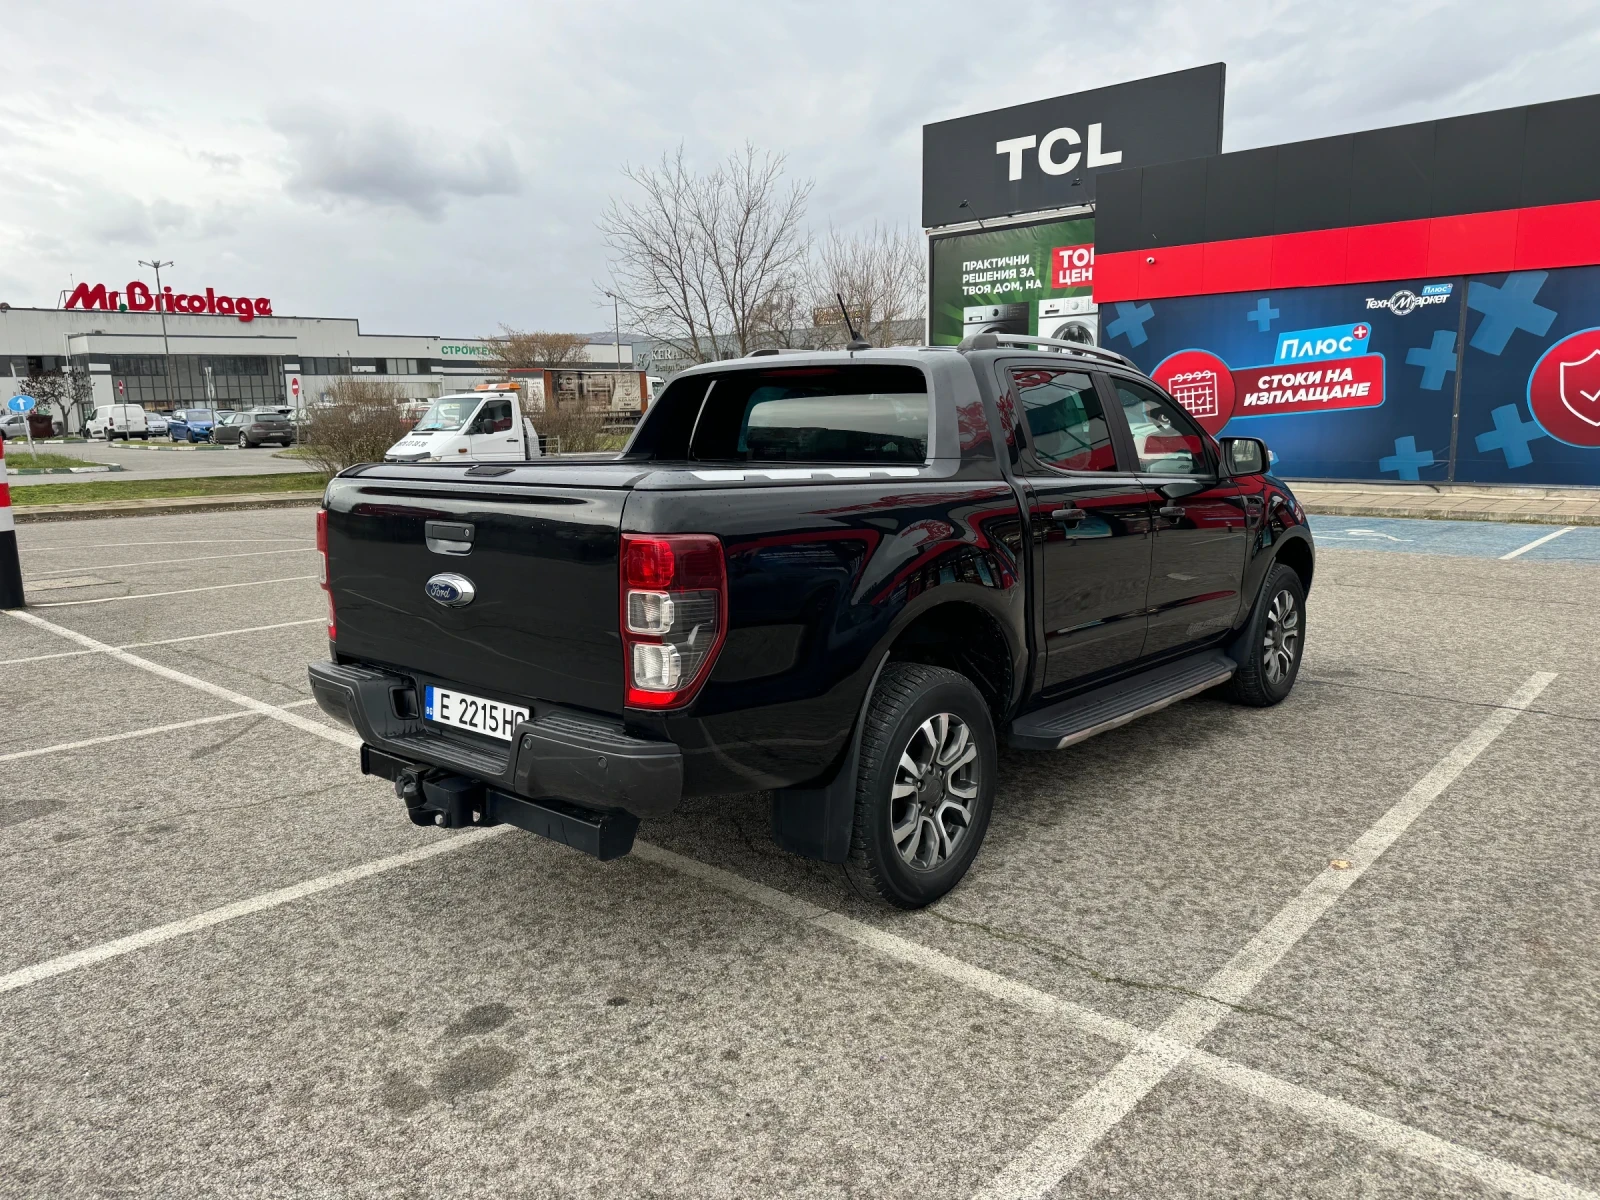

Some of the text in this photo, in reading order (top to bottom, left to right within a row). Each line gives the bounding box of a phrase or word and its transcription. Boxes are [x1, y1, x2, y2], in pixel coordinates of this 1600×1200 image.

[996, 122, 1123, 181] TCL
[962, 254, 1030, 272] ПРАКТИЧНИ
[962, 266, 1036, 284] РЕШЕНИЯ ЗА
[962, 278, 1043, 296] ТВОЯ ДОМ, НА
[1257, 367, 1354, 389] СТОКИ НА
[1243, 382, 1372, 407] ИЗПЛАЩАНЕ
[430, 582, 451, 599] Ford
[440, 692, 451, 721] E
[458, 698, 499, 732] 2215
